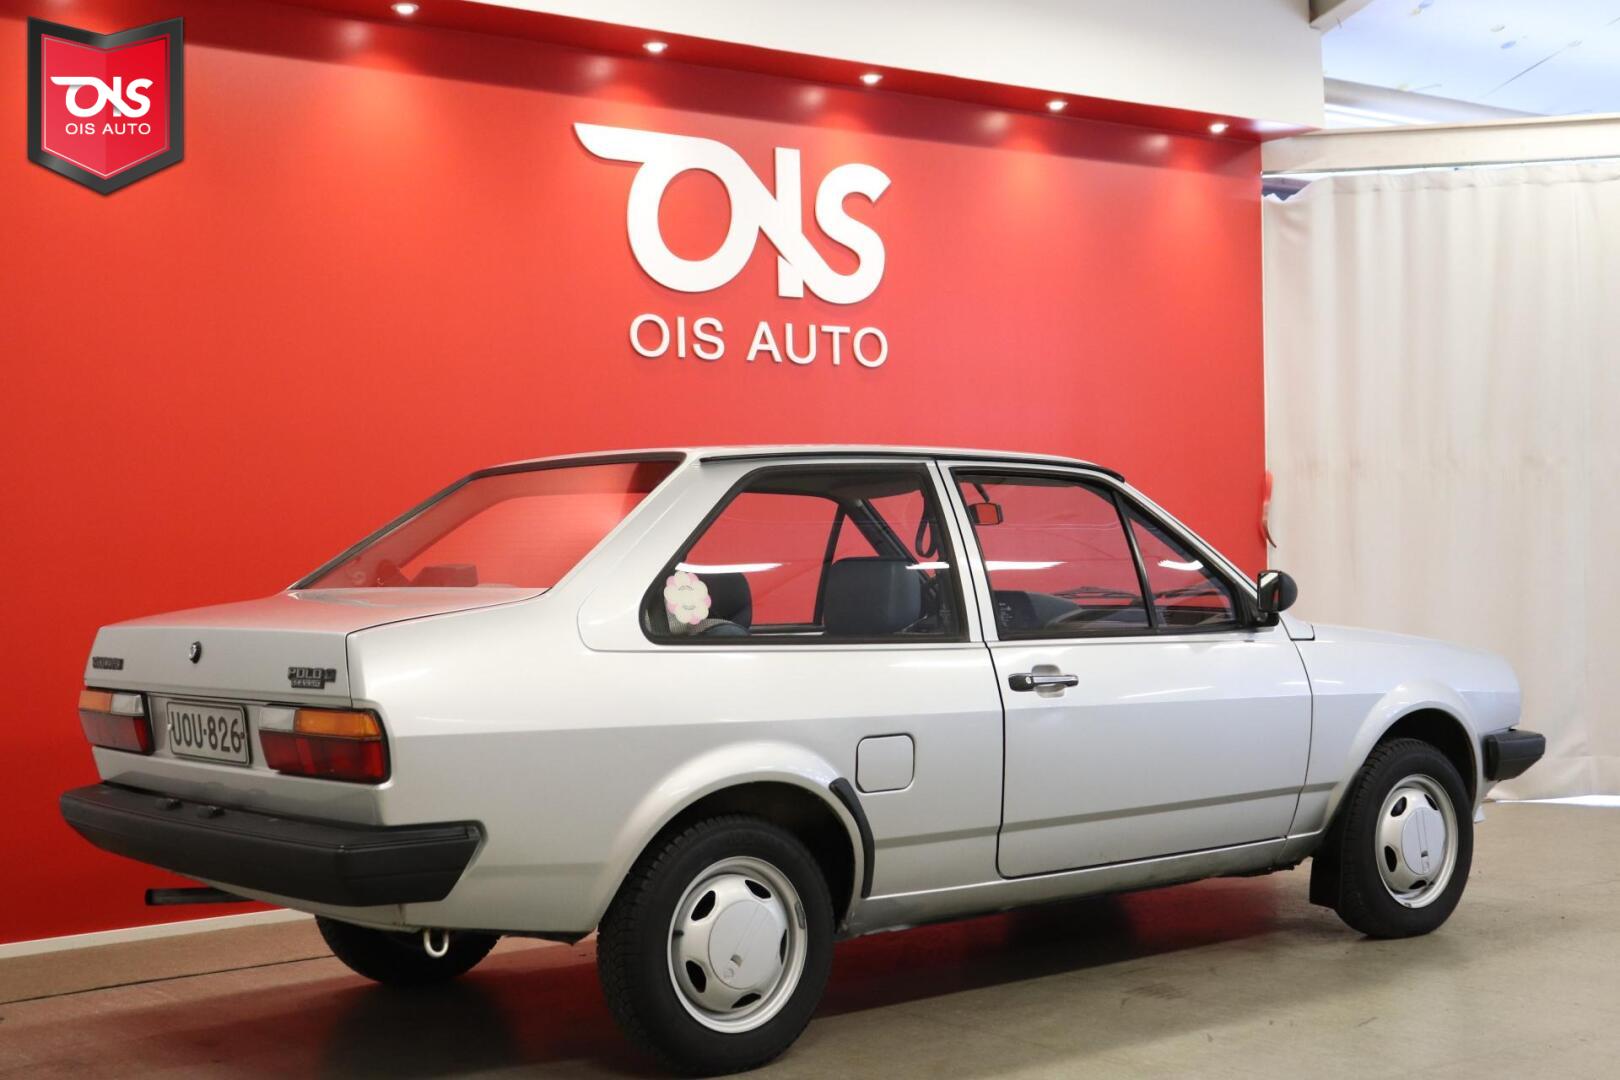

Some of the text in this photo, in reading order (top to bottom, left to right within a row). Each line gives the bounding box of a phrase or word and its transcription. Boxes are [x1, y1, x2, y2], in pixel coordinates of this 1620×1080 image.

[573, 122, 892, 304] OIS
[629, 313, 889, 368] OIS AUTO
[288, 667, 323, 680] POLO
[171, 711, 242, 754] UOU-826
